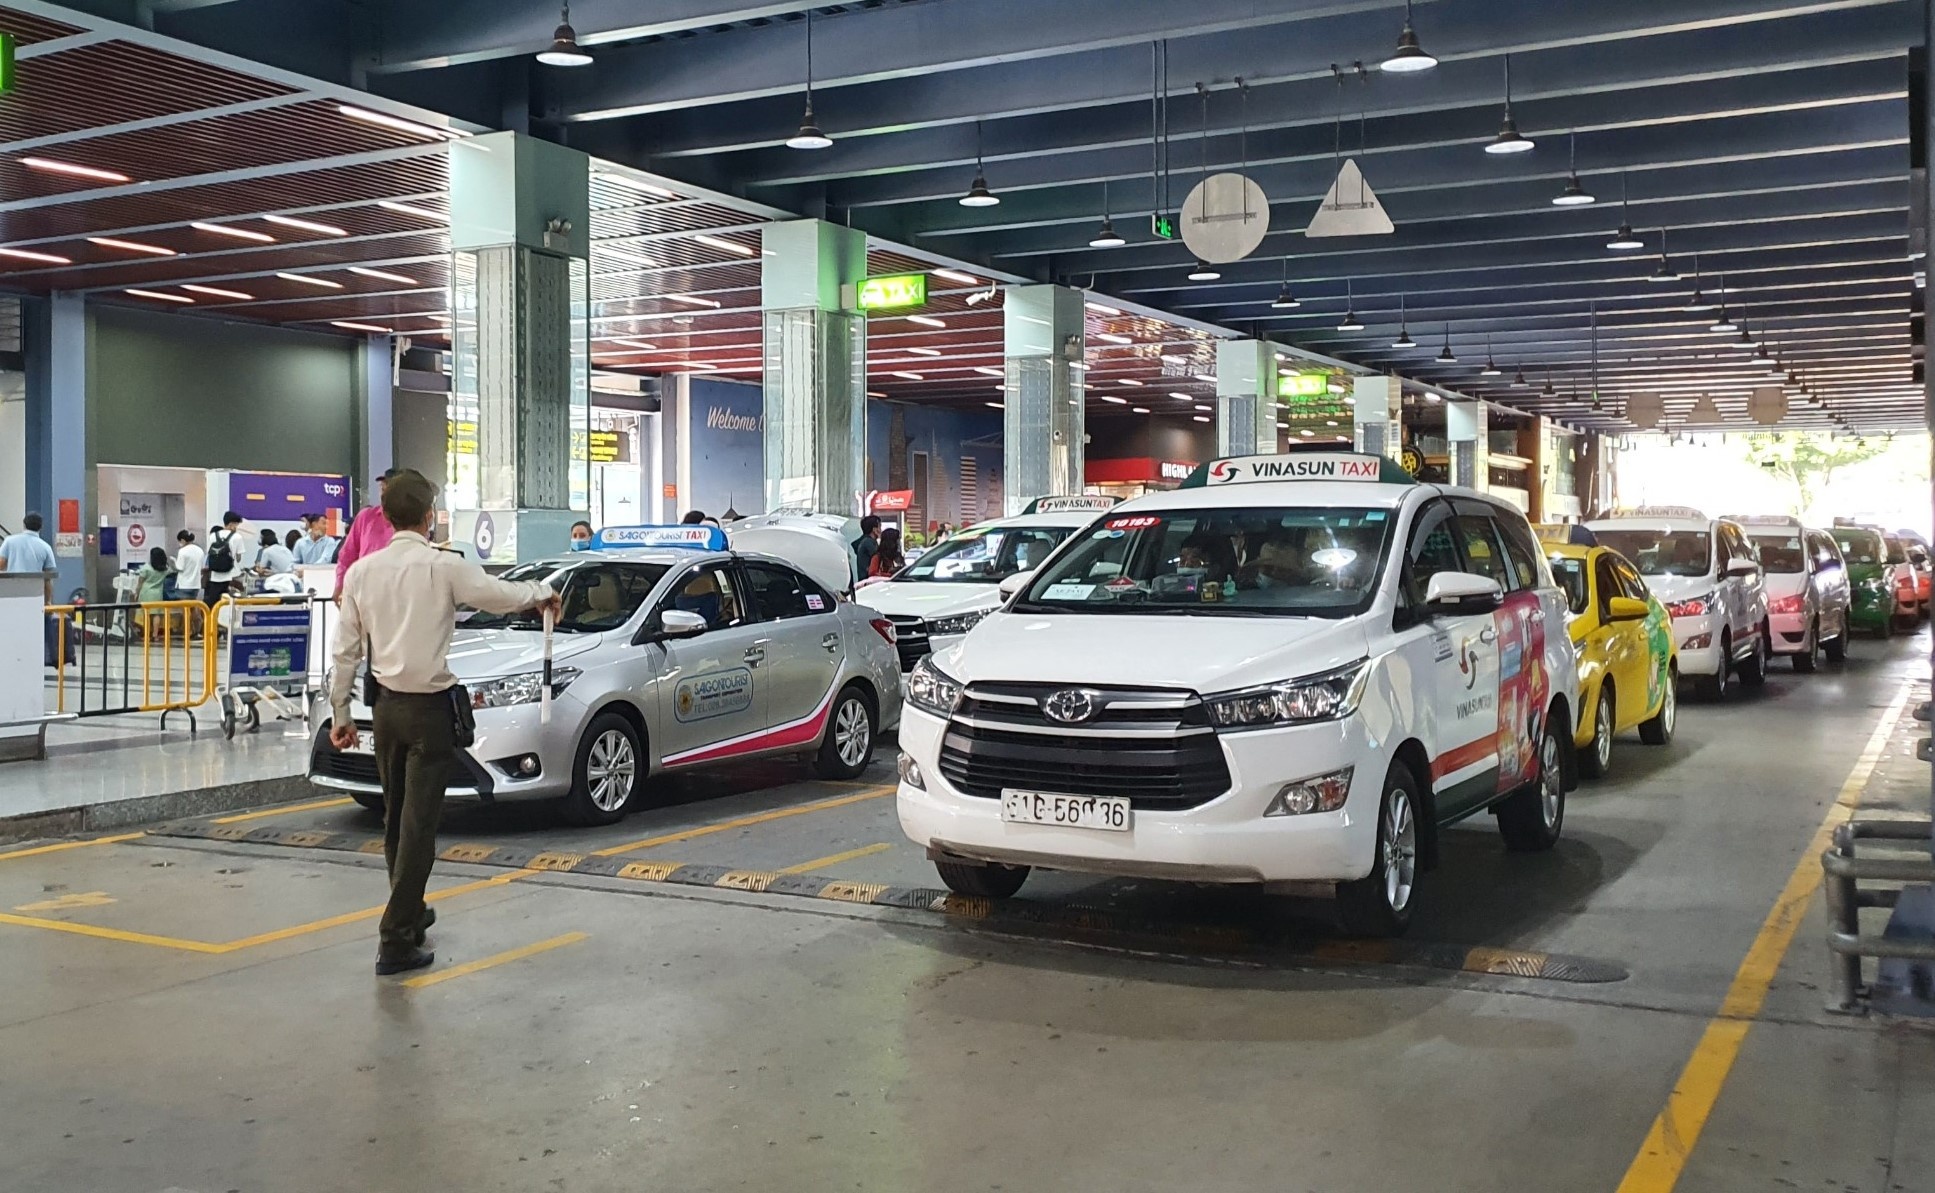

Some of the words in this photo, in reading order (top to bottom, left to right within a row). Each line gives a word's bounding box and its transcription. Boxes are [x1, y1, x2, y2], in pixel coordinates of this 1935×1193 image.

[707, 405, 756, 432] Welcome
[1162, 462, 1196, 480] HIGHLA
[1252, 461, 1335, 477] VINASUN
[1340, 461, 1378, 476] TAXI
[476, 520, 492, 551] 6
[618, 530, 683, 541] SAIGOTOURIST
[685, 530, 706, 540] TAXI
